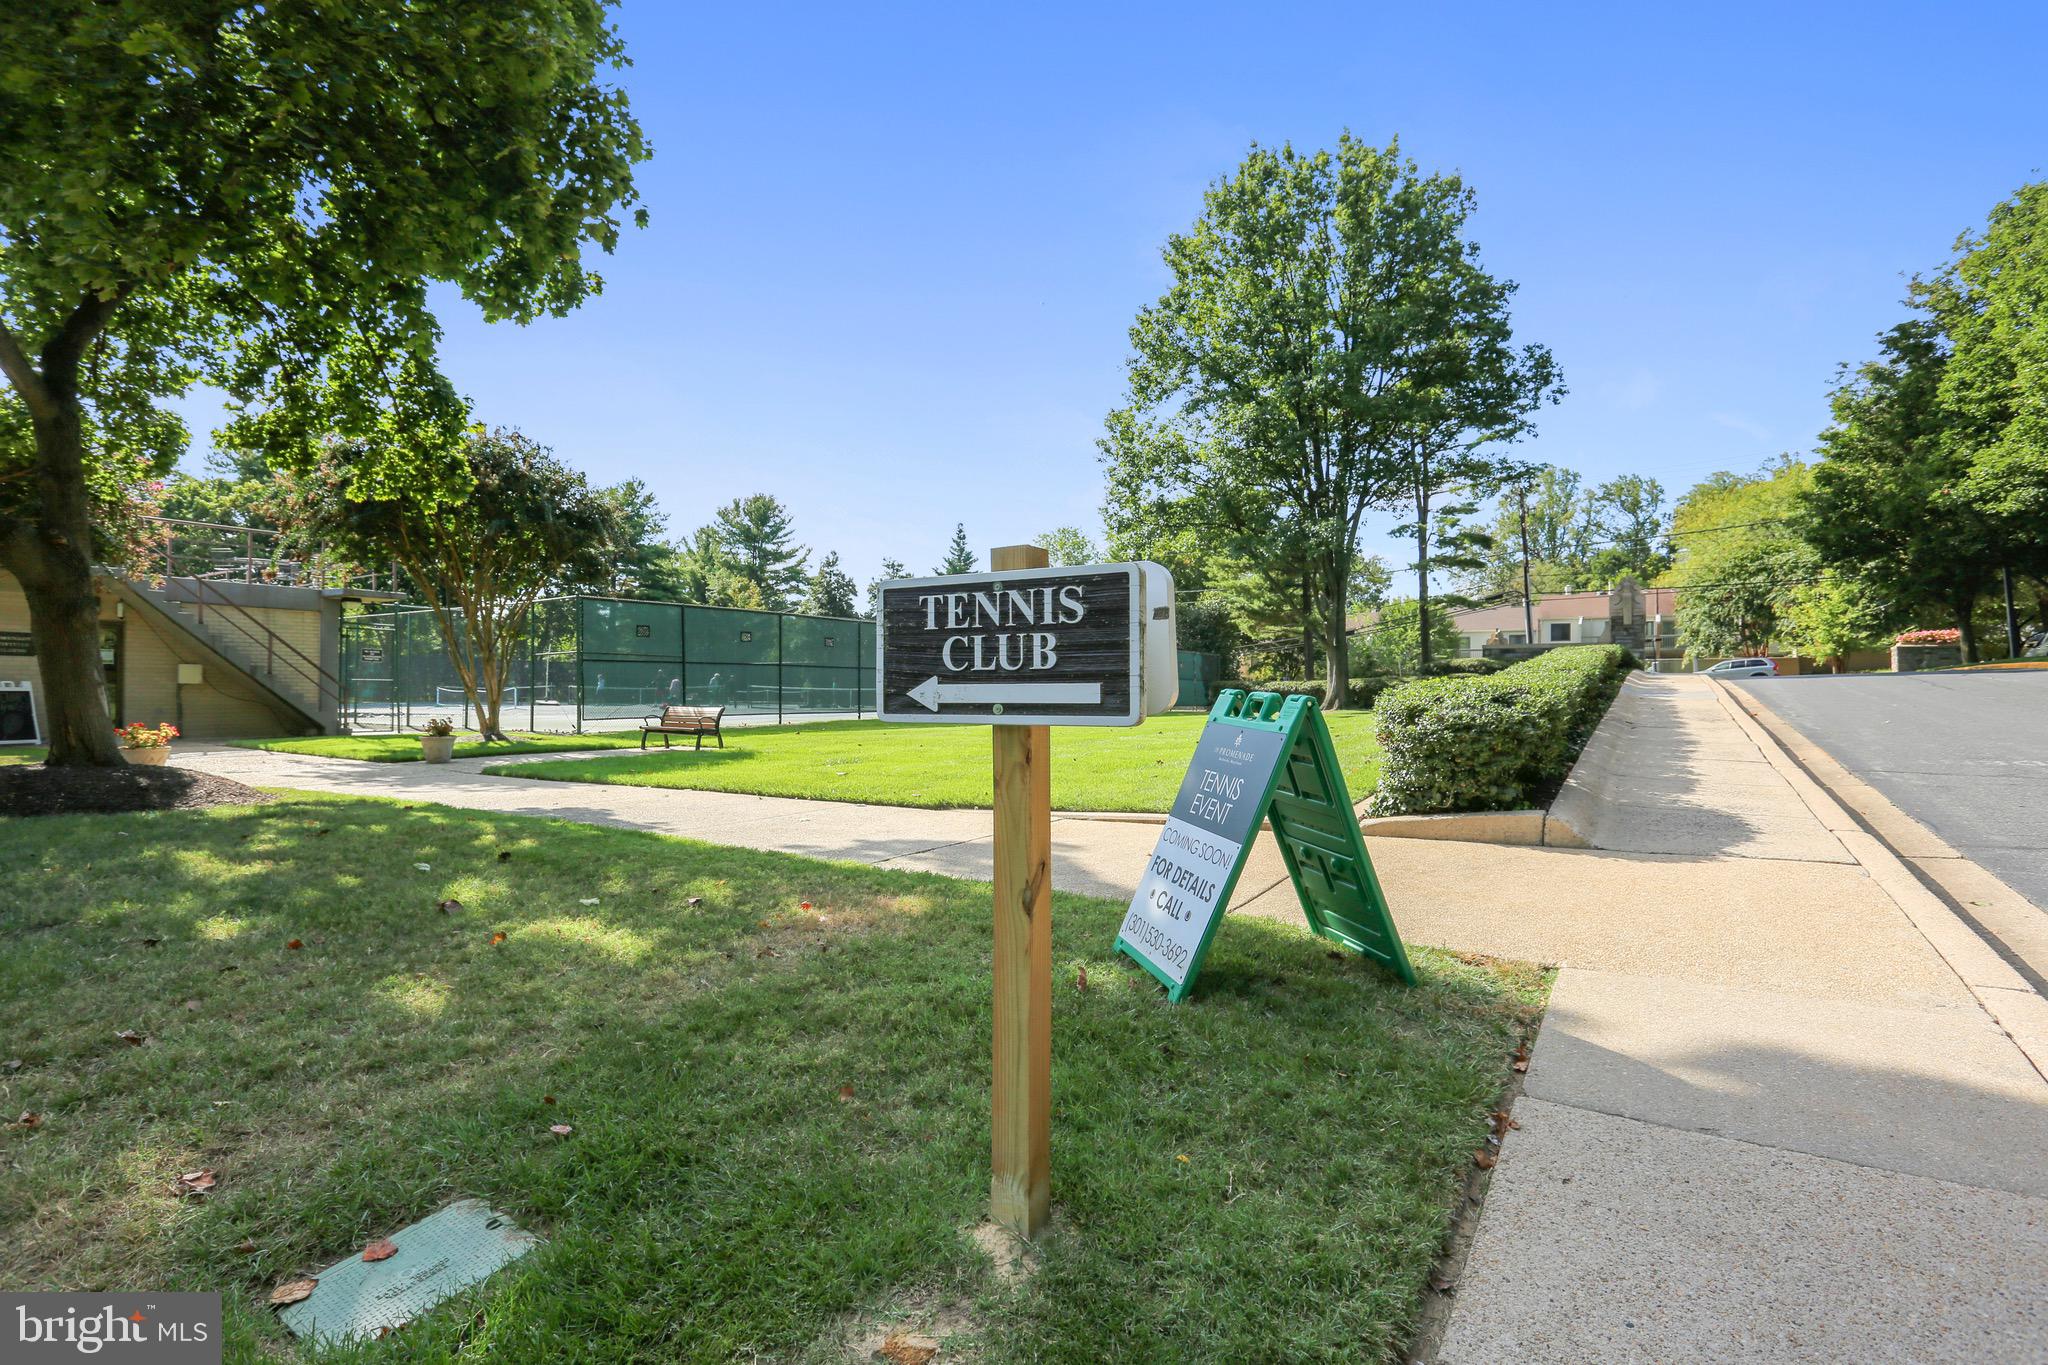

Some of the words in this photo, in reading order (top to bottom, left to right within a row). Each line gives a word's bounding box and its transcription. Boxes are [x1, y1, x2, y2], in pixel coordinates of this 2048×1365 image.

[919, 585, 1087, 630] TENNIS
[942, 633, 1057, 672] CLUB
[1218, 747, 1255, 762] PROMENADE
[1200, 769, 1244, 800] TENNIS
[1189, 793, 1233, 824] EVENT
[1163, 827, 1200, 854] COMING
[1199, 843, 1233, 870] SOON!
[1151, 855, 1173, 880] FOR
[1171, 866, 1215, 903] DETAILS
[1156, 890, 1183, 920] CALL
